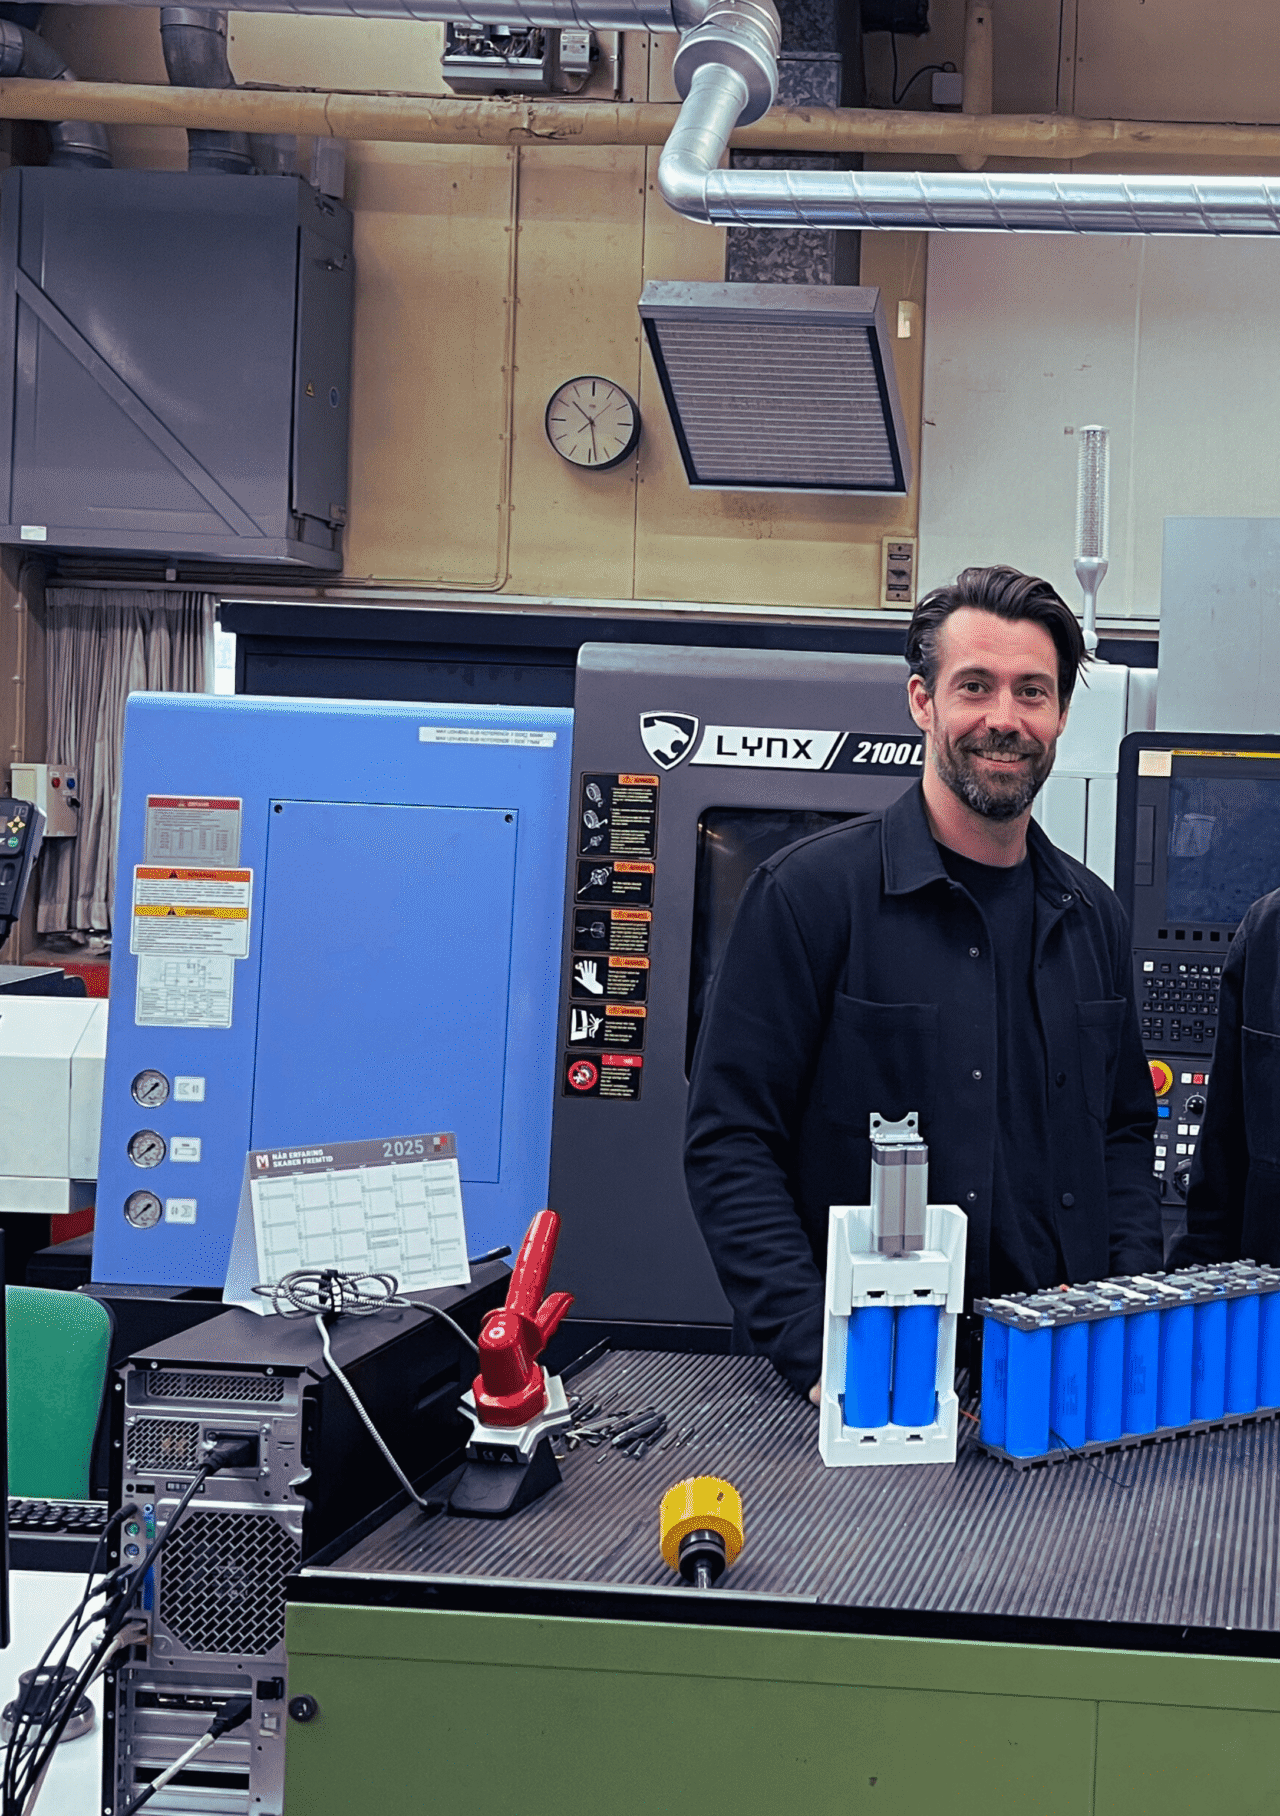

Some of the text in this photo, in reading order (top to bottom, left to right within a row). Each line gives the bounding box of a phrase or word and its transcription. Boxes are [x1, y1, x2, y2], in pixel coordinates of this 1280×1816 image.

[716, 735, 923, 766] LYNX 2100L
[272, 1149, 323, 1161] NÅR ERFARING
[382, 1139, 424, 1157] 2025
[273, 1155, 334, 1168] SKABER FREMTID
